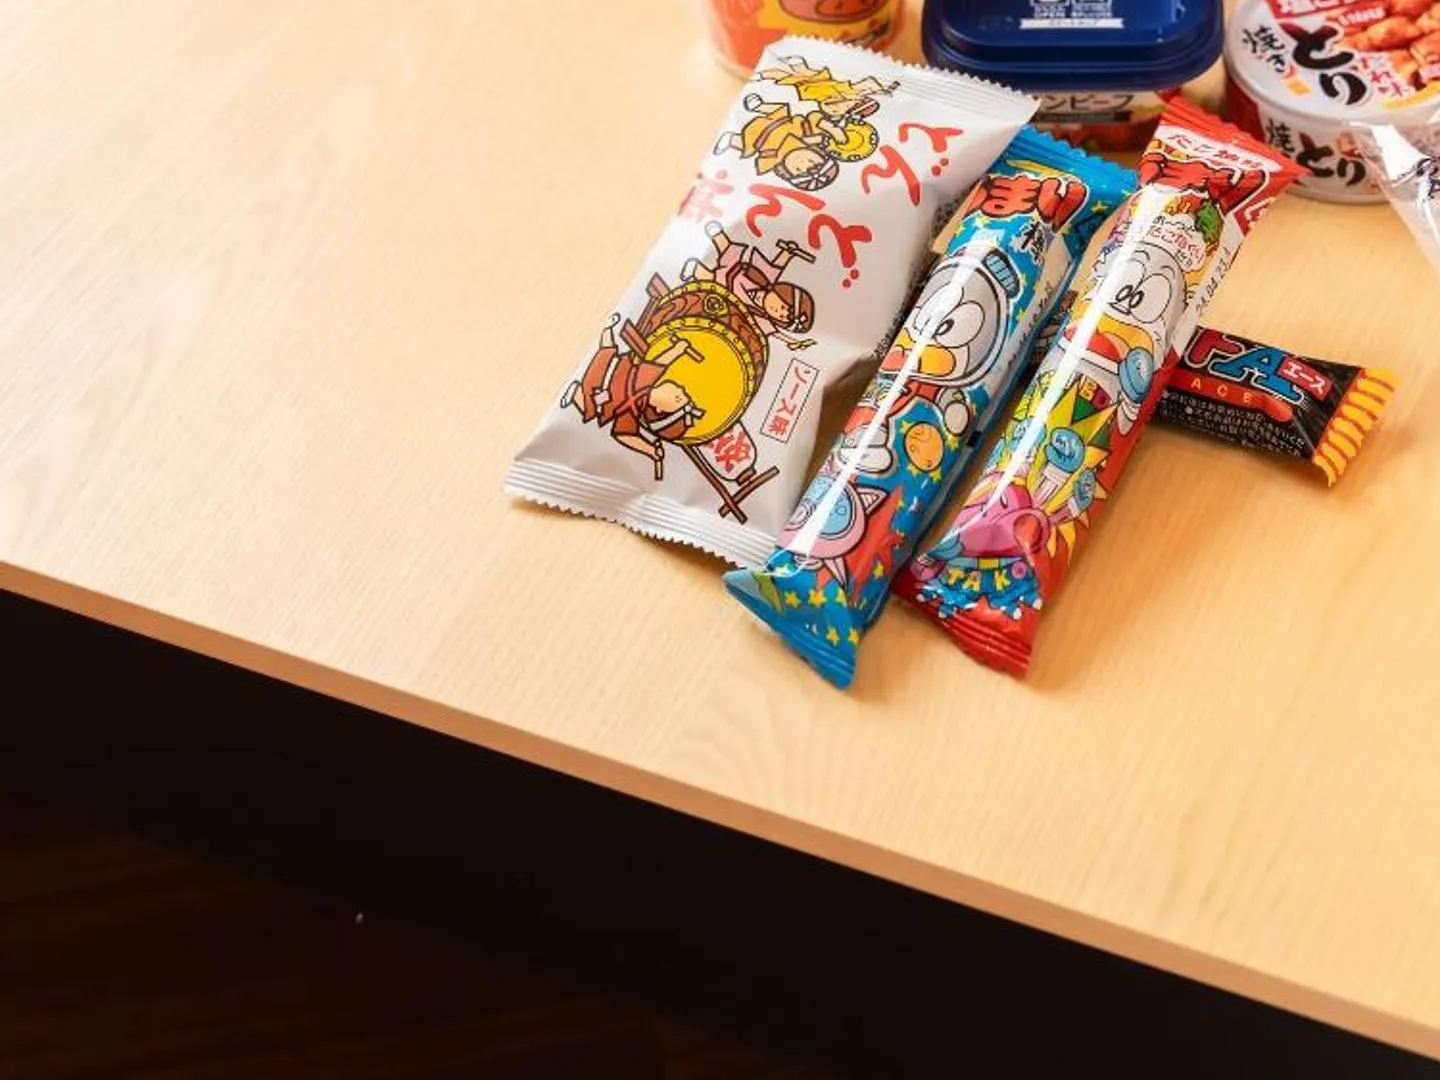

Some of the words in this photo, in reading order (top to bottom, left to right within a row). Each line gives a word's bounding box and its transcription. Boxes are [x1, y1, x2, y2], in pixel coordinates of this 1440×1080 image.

[1033, 94, 1135, 111] ンビーフ
[1282, 361, 1327, 395] エース
[767, 365, 814, 437] ソース味
